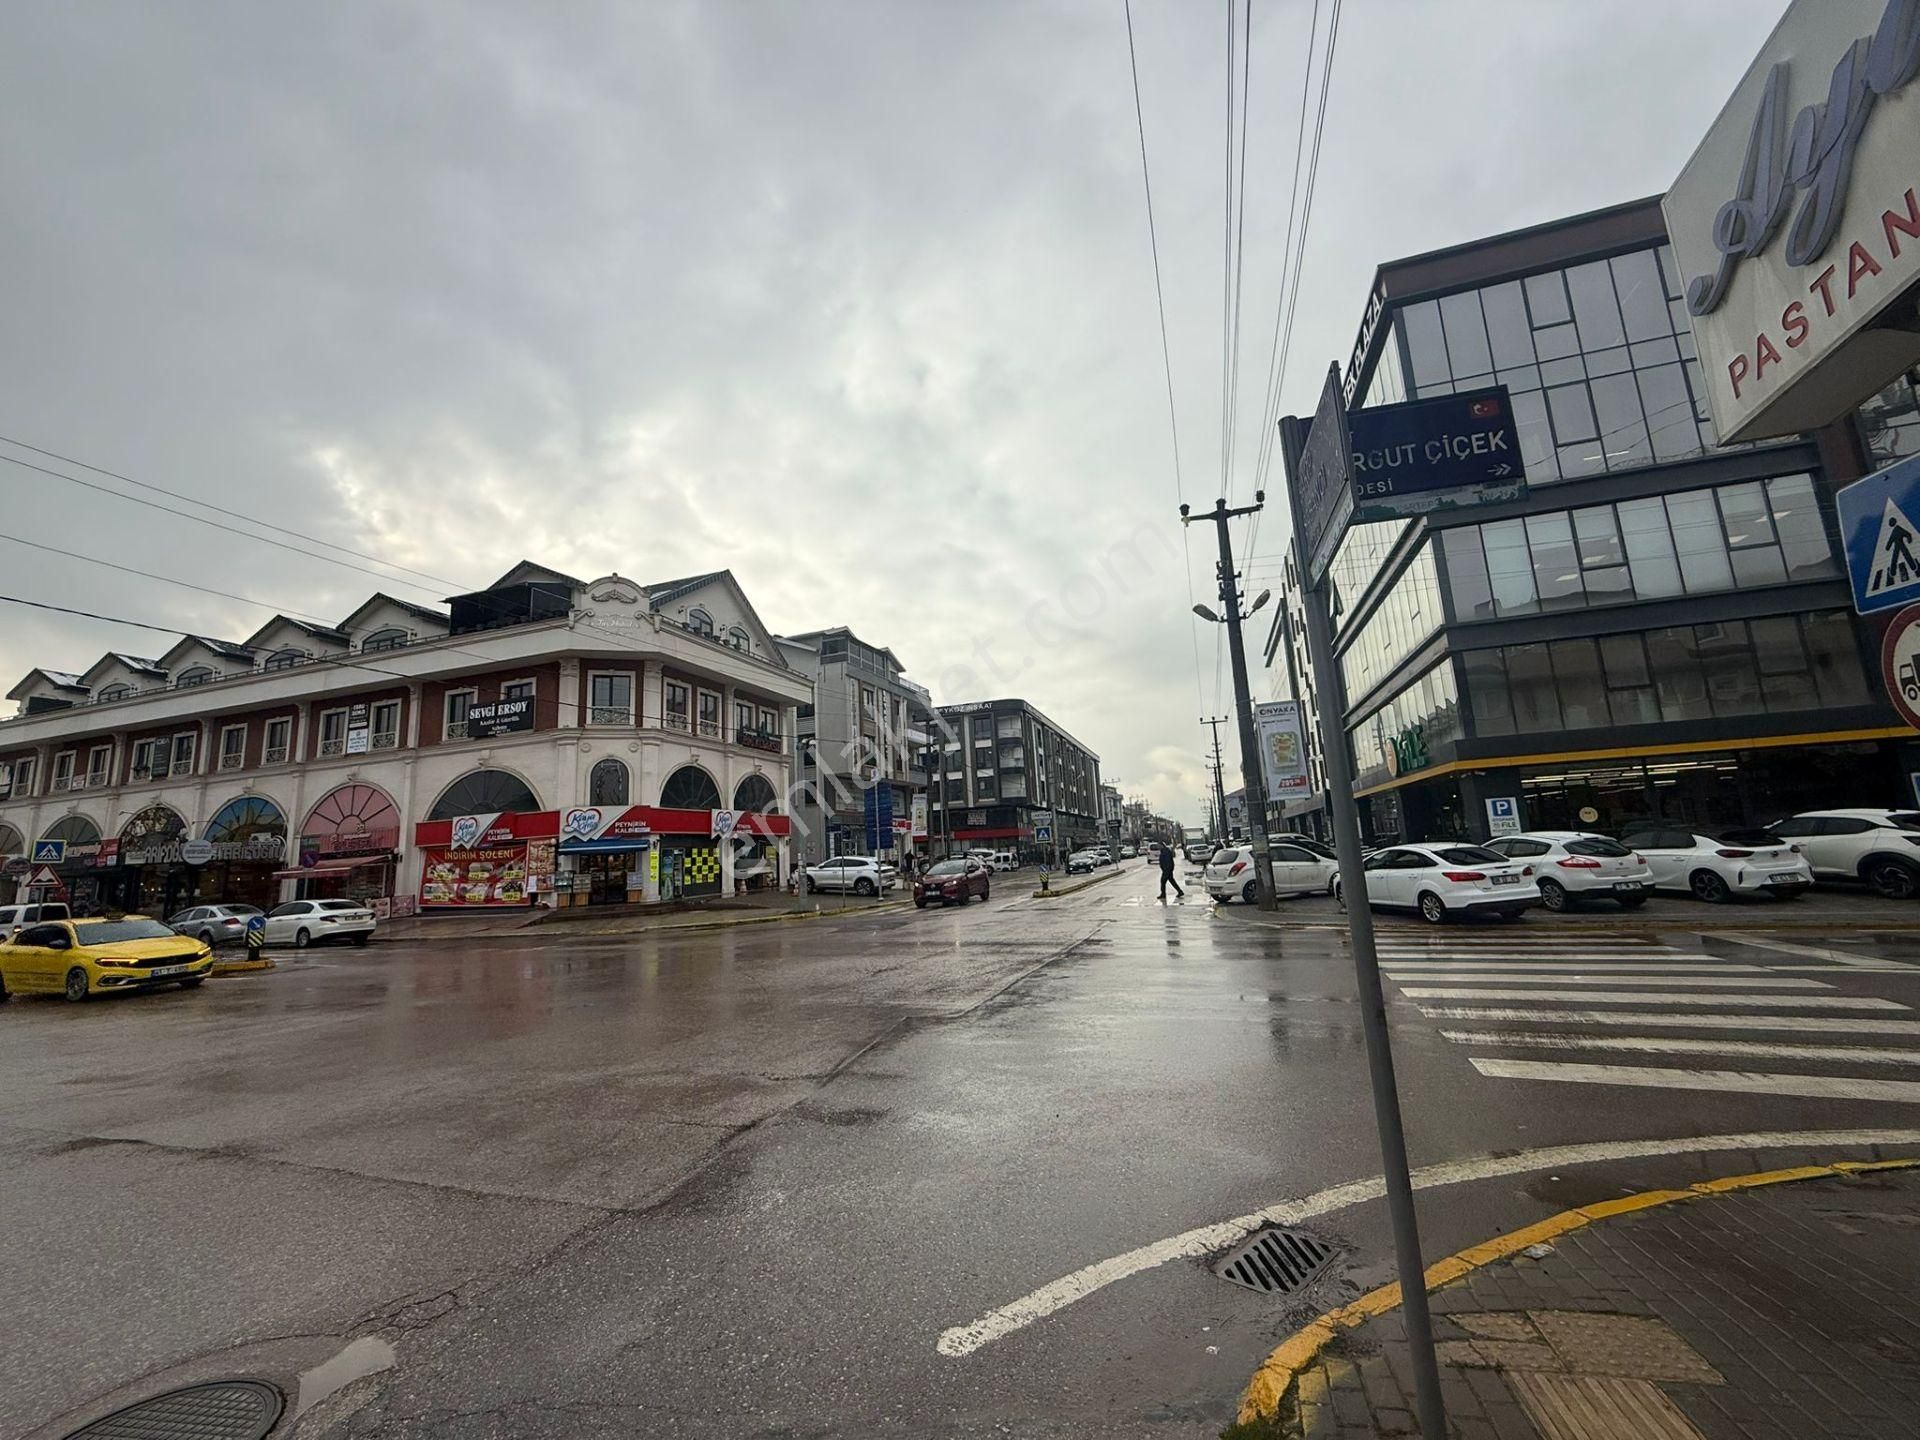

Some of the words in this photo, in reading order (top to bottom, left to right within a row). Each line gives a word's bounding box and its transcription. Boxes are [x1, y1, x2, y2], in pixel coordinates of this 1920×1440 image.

[1727, 188, 1920, 399] PASTAN
[1424, 429, 1509, 465] ÇİÇEK
[469, 703, 496, 719] SEVGİ
[497, 700, 528, 716] ERSOY
[444, 849, 477, 861] İNDİRİM
